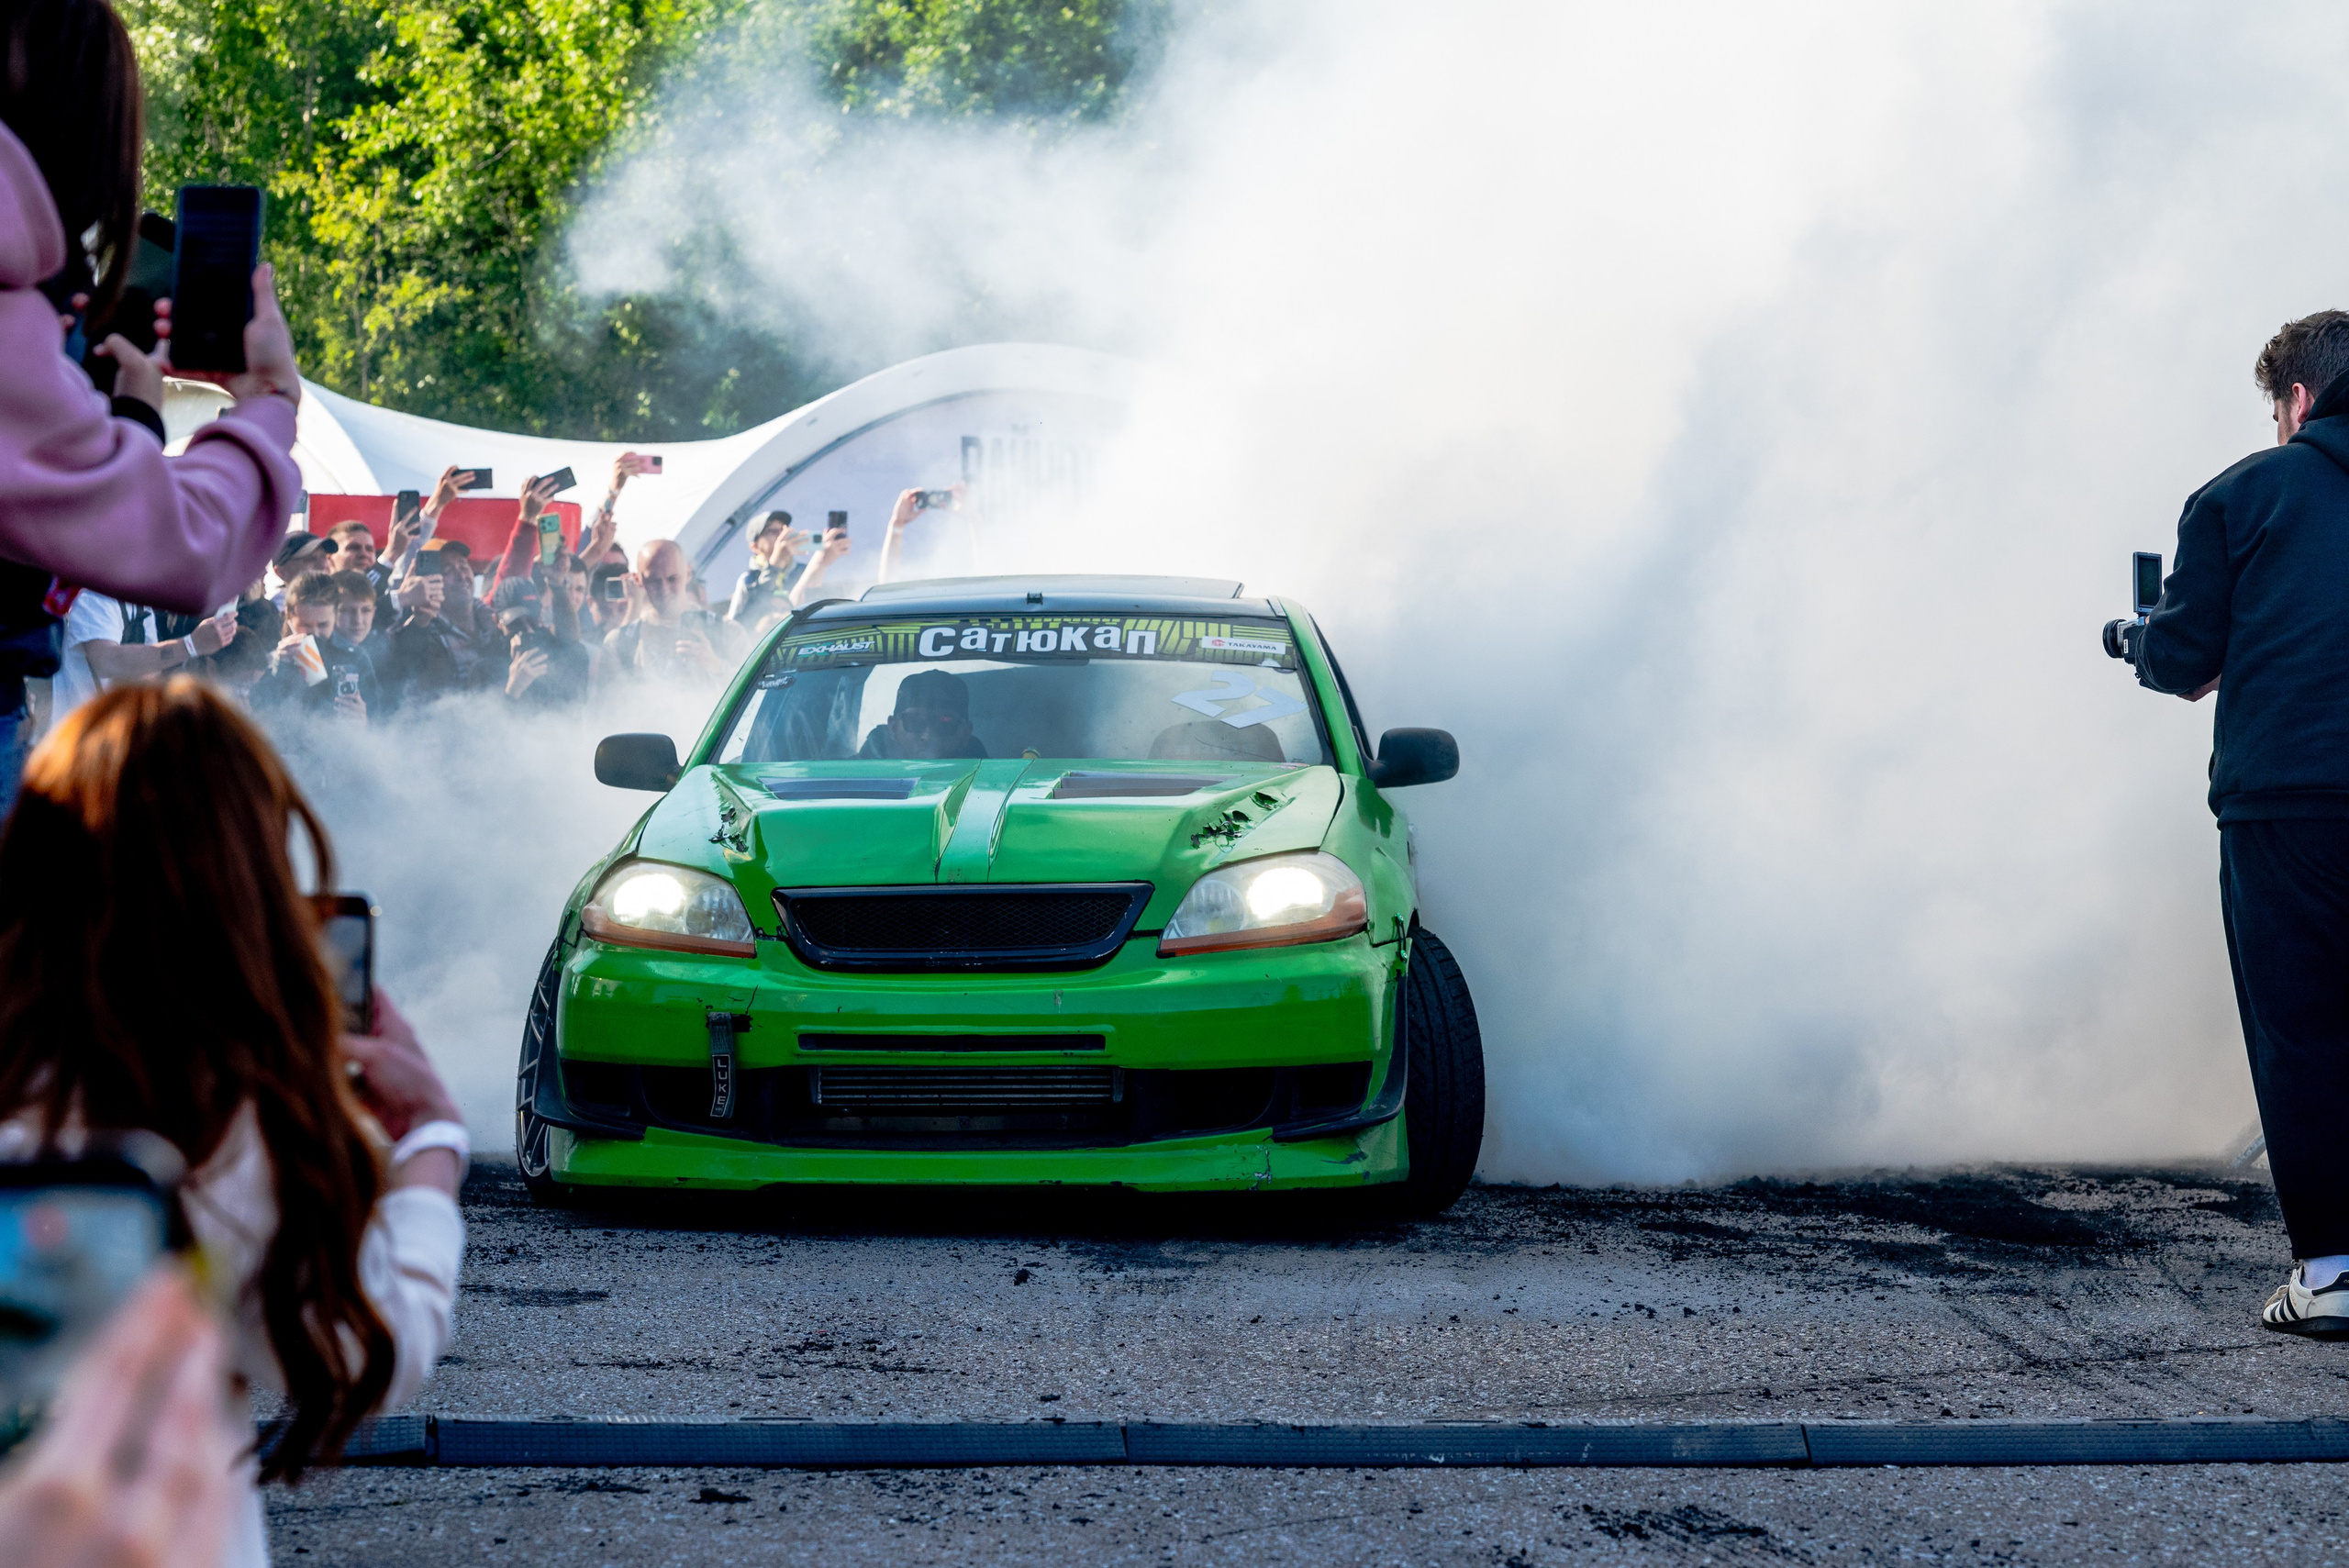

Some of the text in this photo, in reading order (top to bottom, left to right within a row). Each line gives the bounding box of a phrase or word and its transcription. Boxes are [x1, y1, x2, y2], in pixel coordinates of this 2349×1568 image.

[797, 640, 875, 656] EXHAUST
[1227, 641, 1277, 651] TAKAYAMA
[717, 1059, 728, 1105] LUKE
